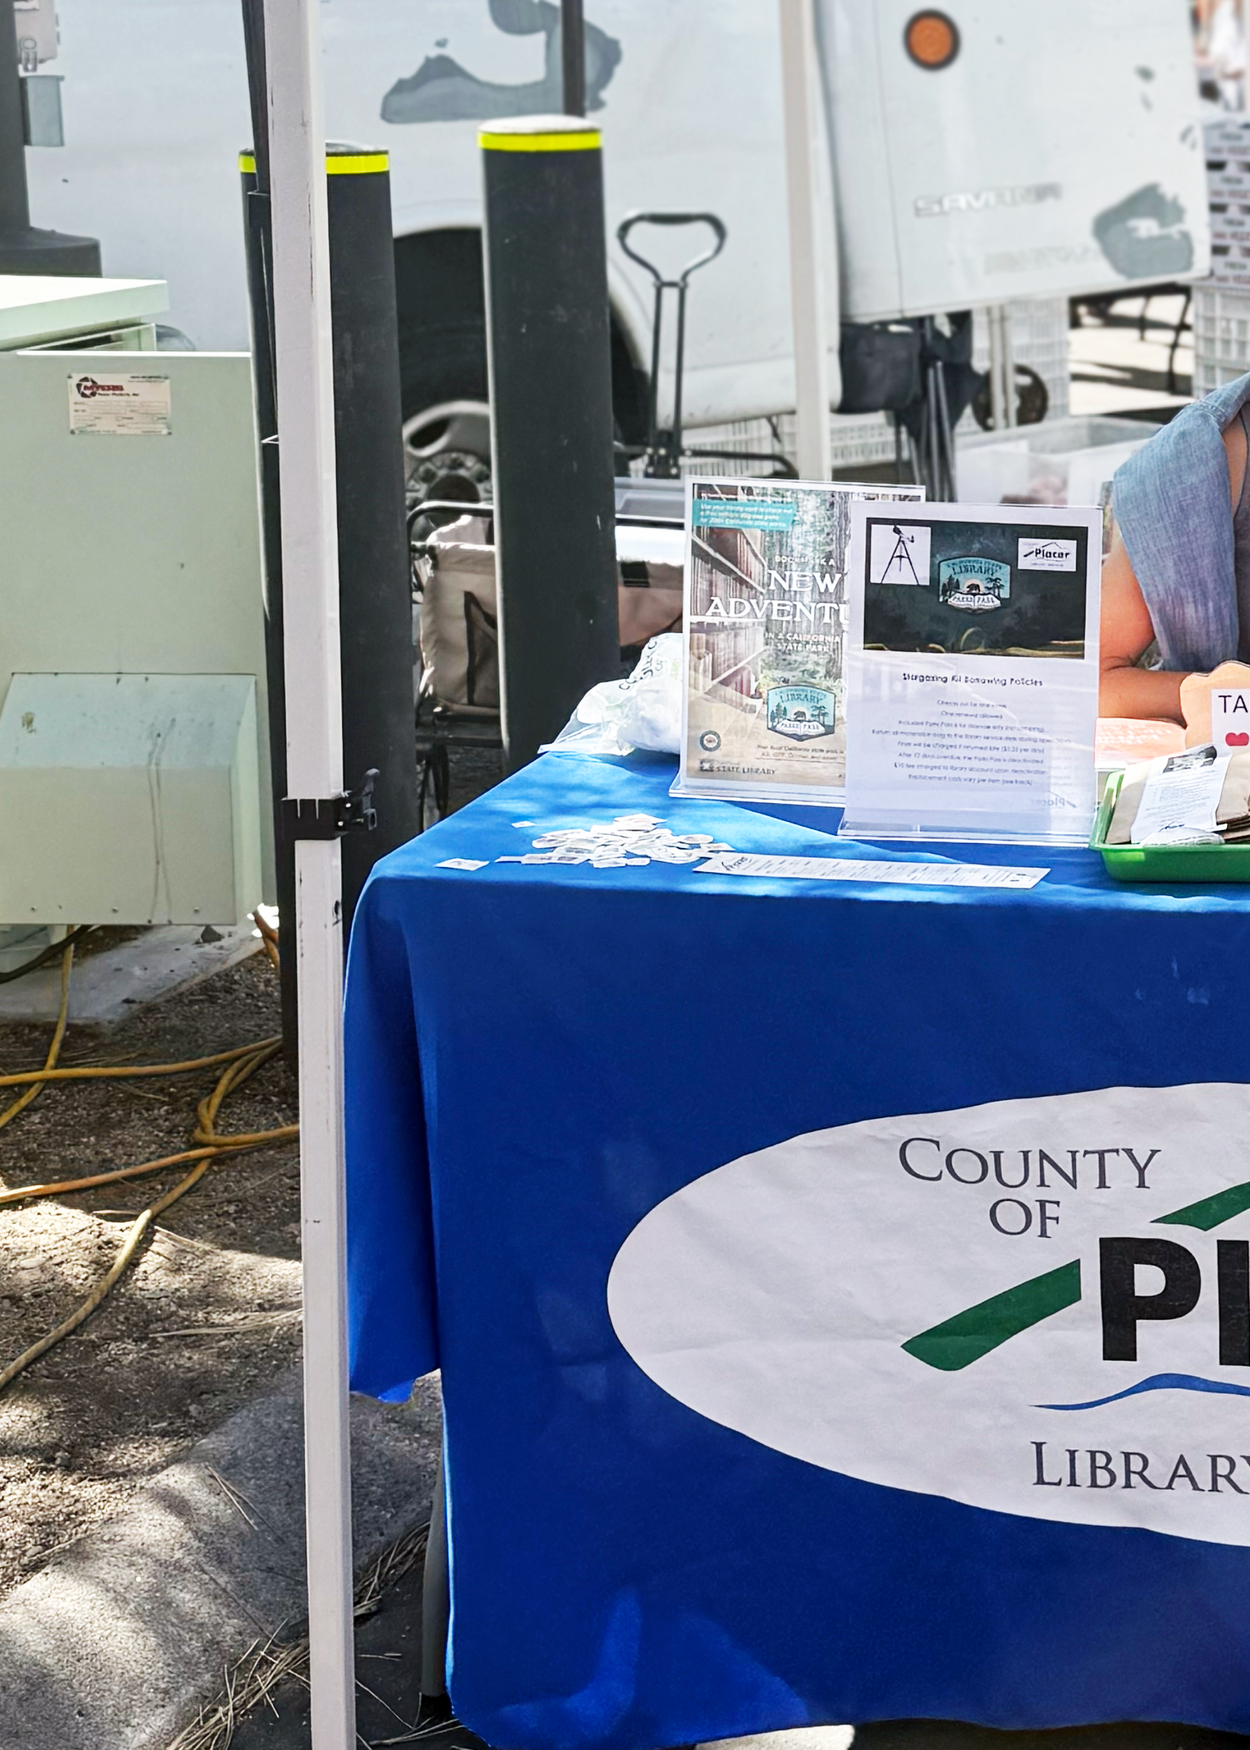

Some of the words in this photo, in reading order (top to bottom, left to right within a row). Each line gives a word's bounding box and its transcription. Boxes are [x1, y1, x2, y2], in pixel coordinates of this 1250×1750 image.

[768, 569, 842, 593] NEW
[952, 563, 997, 576] LIBRARY
[964, 676, 1007, 686] Borrowing
[1009, 677, 1043, 686] Policies
[899, 1137, 1162, 1190] COUNTY
[989, 1198, 1061, 1238] OF
